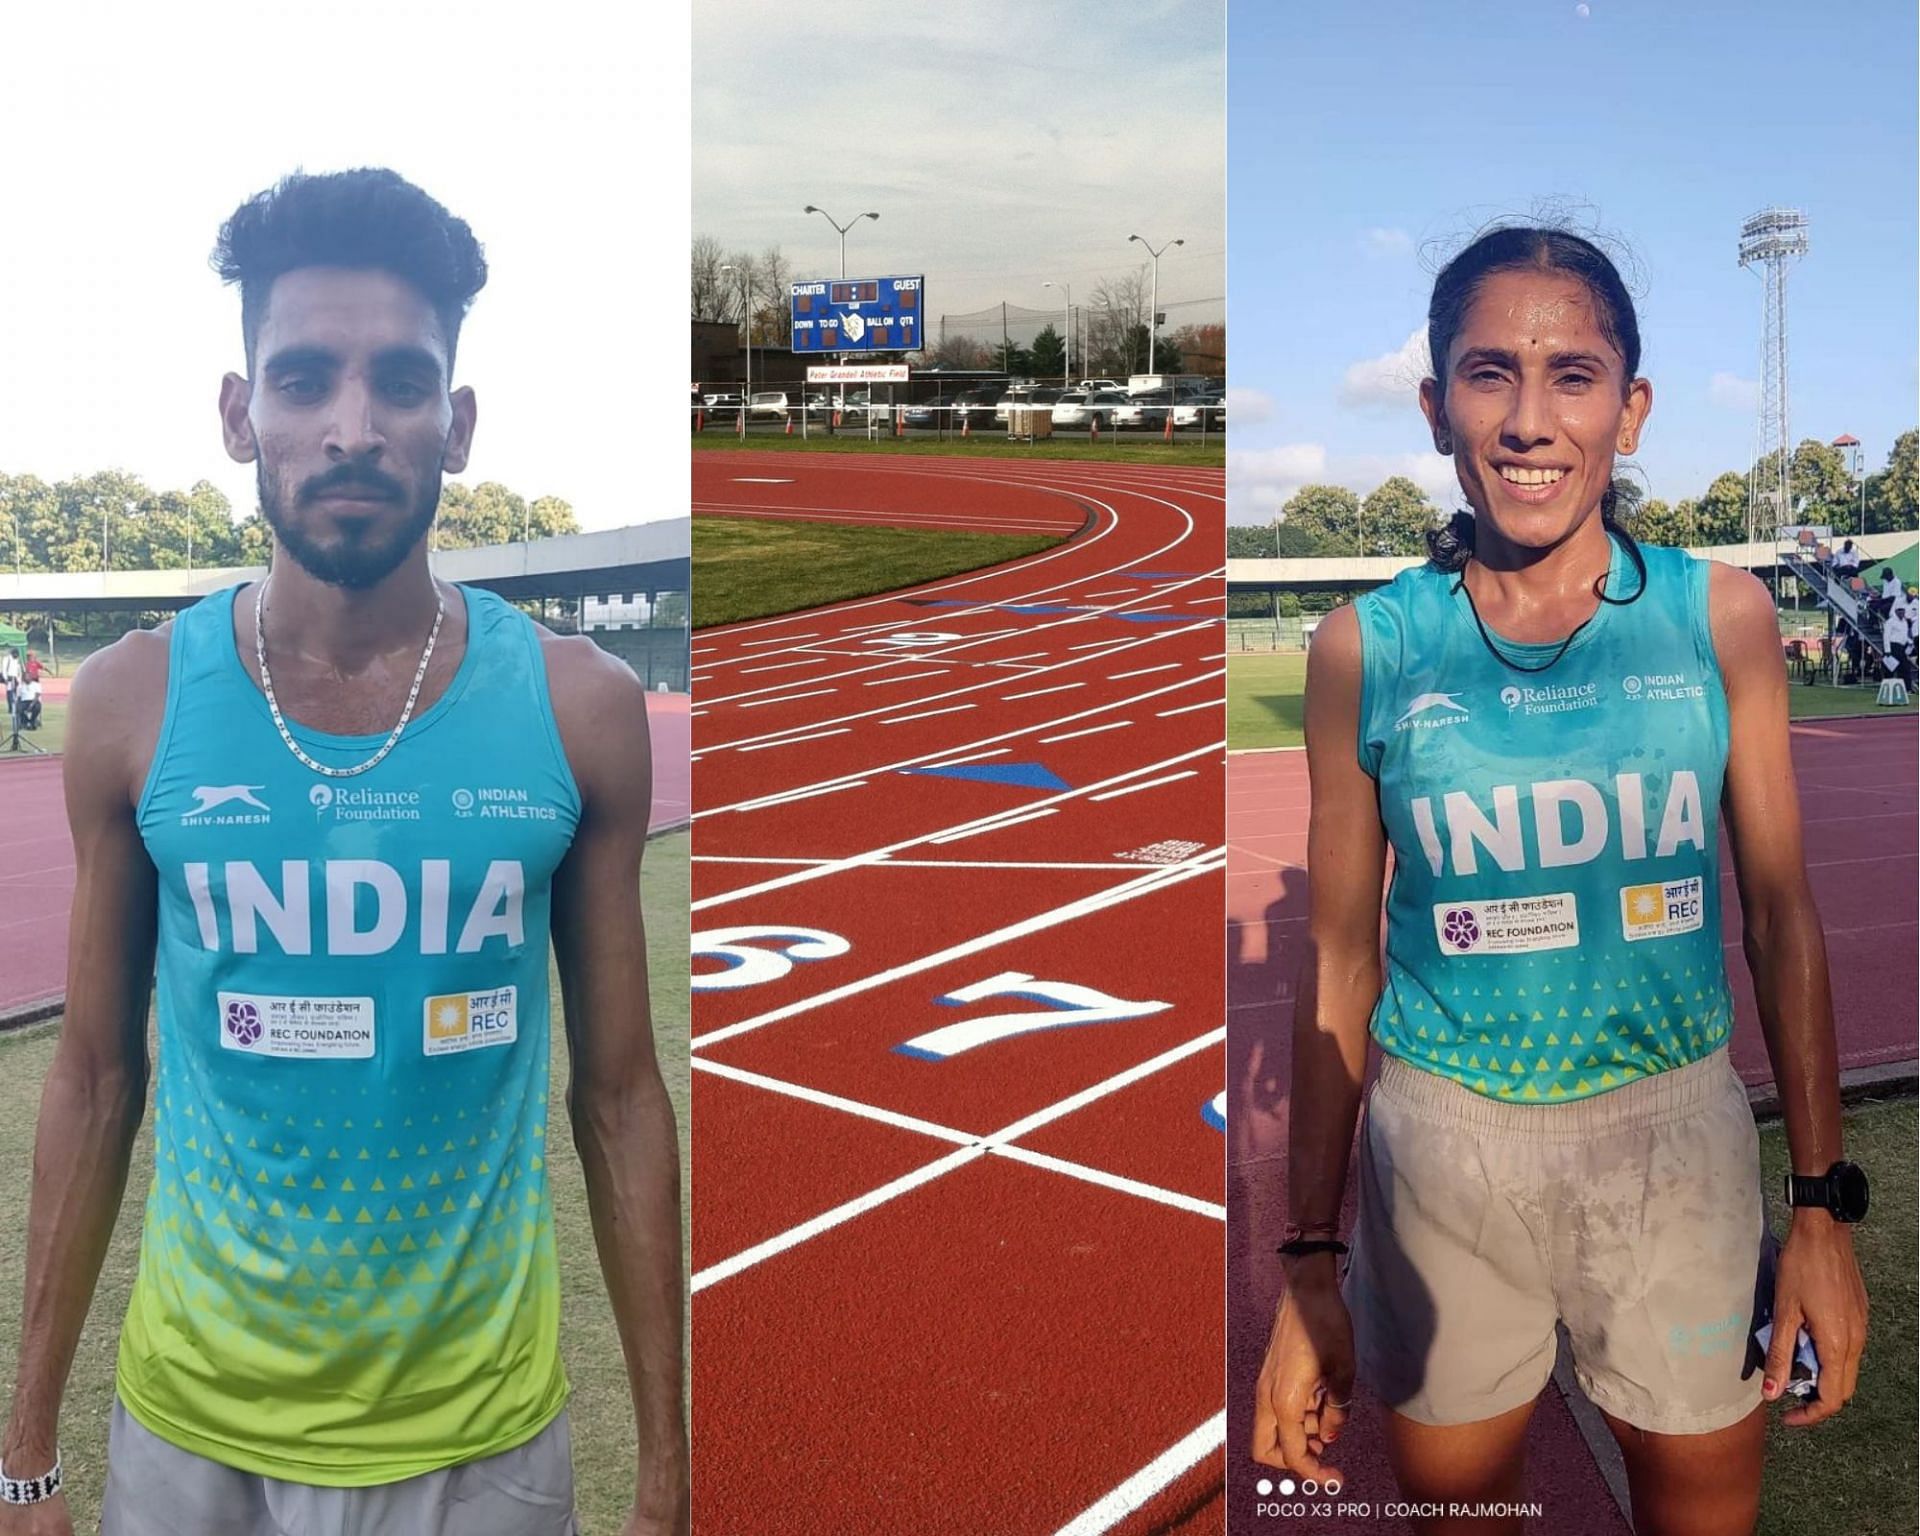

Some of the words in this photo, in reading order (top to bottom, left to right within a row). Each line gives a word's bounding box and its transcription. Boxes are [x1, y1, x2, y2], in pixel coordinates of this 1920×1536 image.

[792, 284, 825, 296] CHARTER
[893, 280, 920, 291] GUEST
[794, 320, 813, 329] DOWN
[819, 319, 828, 328] TO
[829, 319, 838, 328] GO
[867, 317, 882, 326] BALL
[883, 317, 894, 326] ON
[899, 316, 914, 327] QTR
[860, 369, 886, 378] Athletic
[889, 369, 907, 378] Field
[1644, 673, 1684, 686] INDIAN
[1522, 682, 1596, 702] Reliance
[1524, 697, 1598, 715] Foundation
[335, 788, 420, 805] Reliance
[478, 789, 528, 802] INDIAN
[335, 806, 420, 820] Foundation
[480, 805, 557, 820] ATHLETICS
[181, 815, 271, 827] SHIV-NARESH
[1411, 770, 1705, 878] INDIA
[183, 859, 526, 956] INDIA
[1669, 900, 1698, 920] REC
[1486, 929, 1505, 938] REC
[1507, 922, 1574, 937] FOUNDATION
[691, 926, 851, 993] 6
[472, 1011, 508, 1032] REC
[889, 971, 1175, 1061] 7
[270, 1029, 291, 1039] REC
[295, 1030, 370, 1040] FOUNDATION
